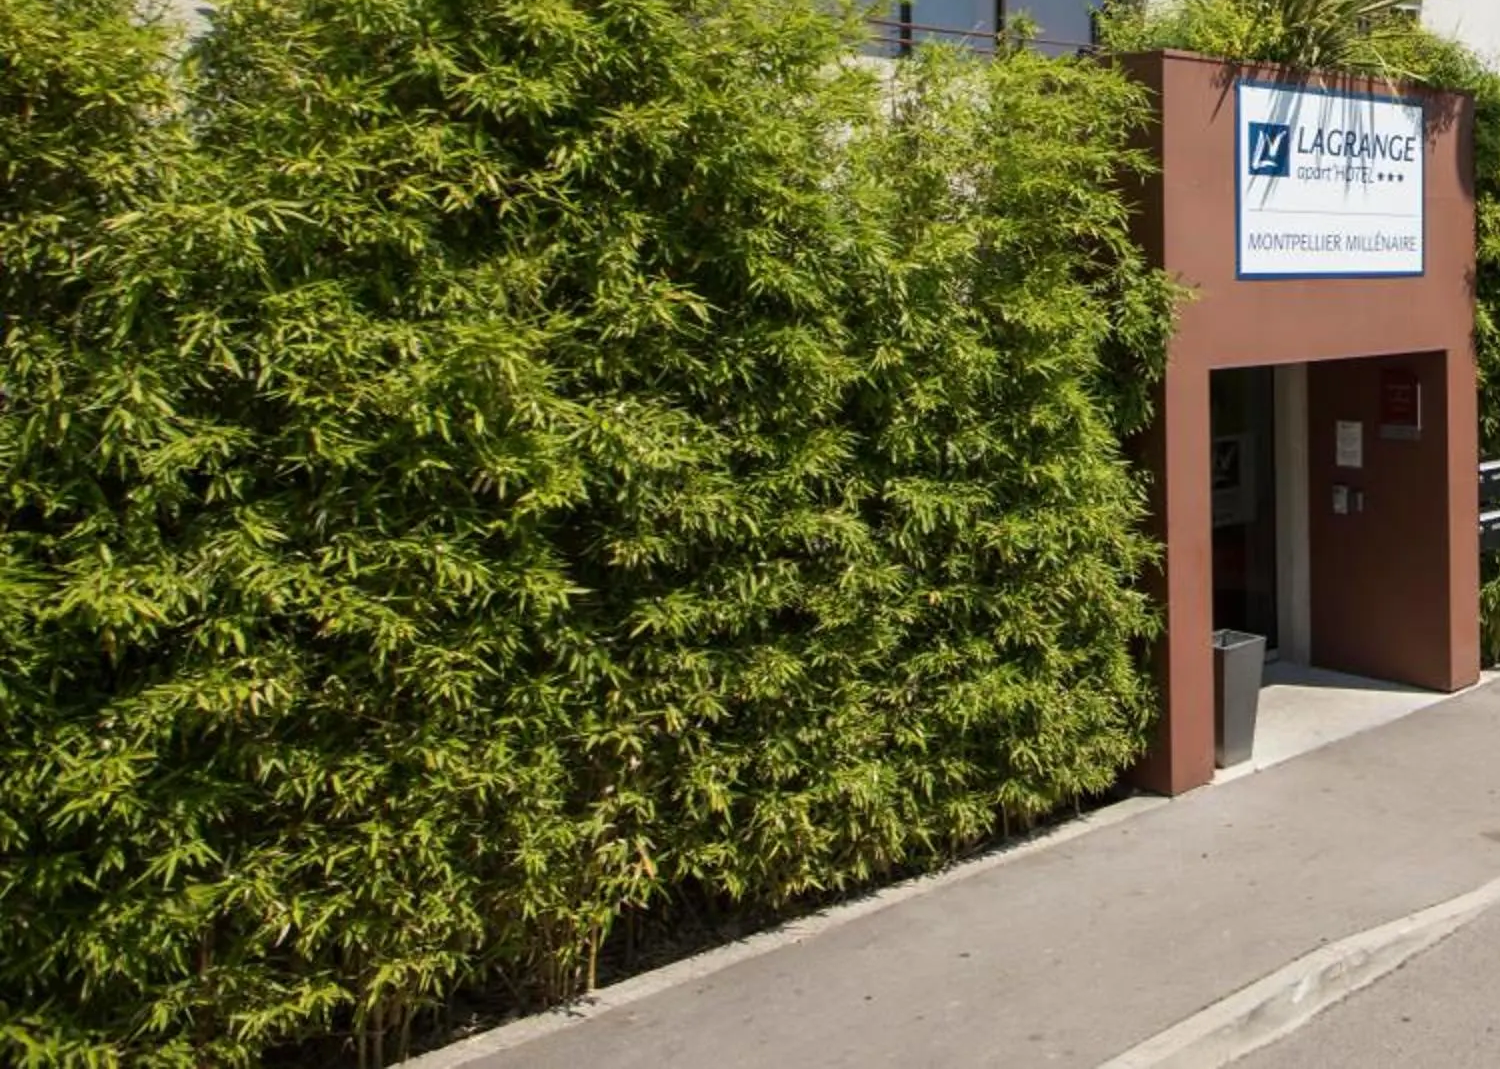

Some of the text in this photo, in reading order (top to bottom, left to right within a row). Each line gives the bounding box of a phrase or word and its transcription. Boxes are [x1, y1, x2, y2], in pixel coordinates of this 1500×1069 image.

[1297, 126, 1416, 162] LAGRANGE
[1248, 231, 1418, 252] MONTPELLIER MILLÉNAIRE
